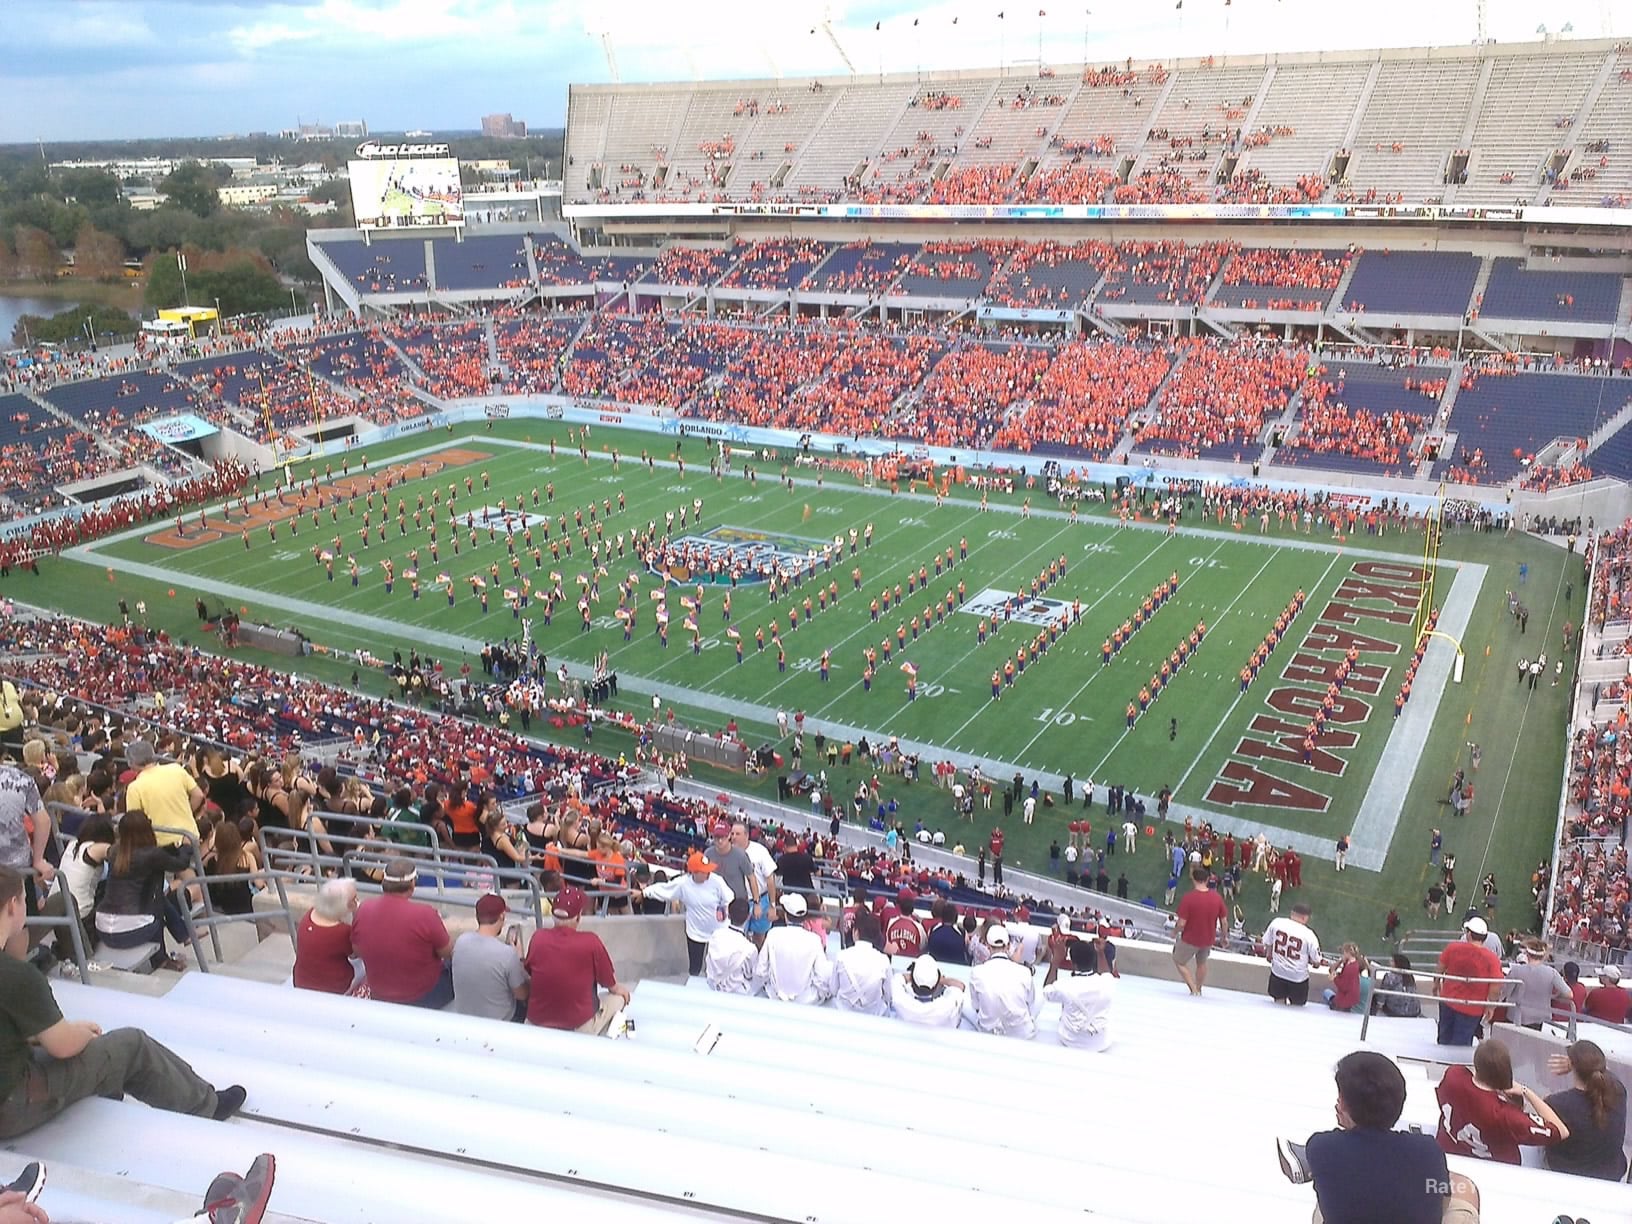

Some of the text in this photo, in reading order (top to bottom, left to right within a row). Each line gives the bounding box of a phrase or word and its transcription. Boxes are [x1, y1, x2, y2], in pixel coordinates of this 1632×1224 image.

[400, 420, 430, 433] ORLAND
[600, 414, 622, 424] ESPN
[684, 423, 722, 435] ORLANDO
[1202, 560, 1434, 812] OKLAHOMA
[1033, 706, 1077, 727] 10
[1274, 929, 1303, 961] 22
[1440, 1102, 1494, 1159] 14
